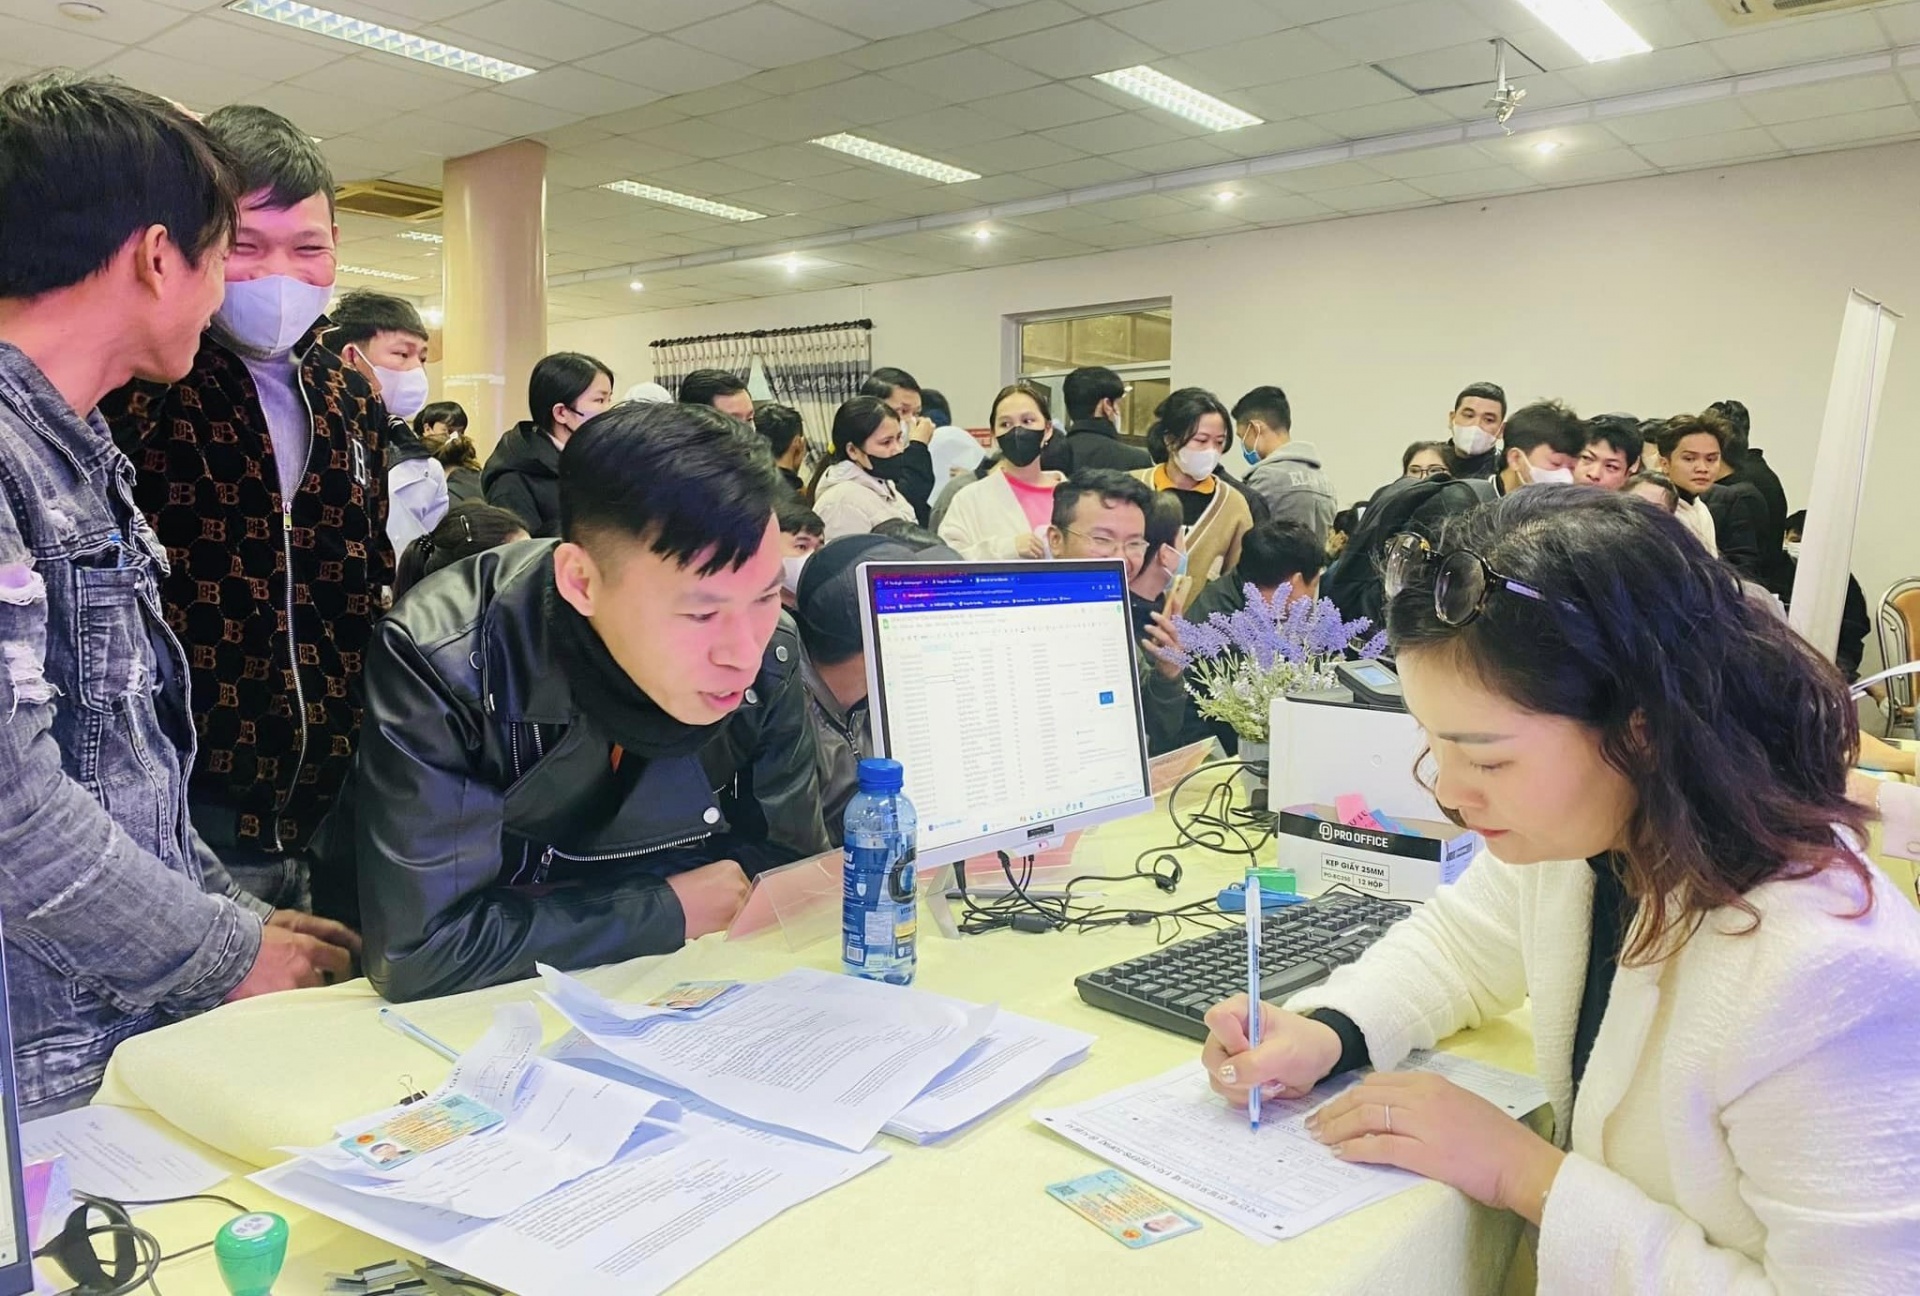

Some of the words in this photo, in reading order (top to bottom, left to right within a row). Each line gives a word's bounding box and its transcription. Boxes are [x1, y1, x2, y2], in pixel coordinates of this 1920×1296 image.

[1333, 828, 1353, 842] PRO
[1353, 832, 1389, 848] OFFICE
[1361, 866, 1385, 876] 25MM
[1358, 878, 1367, 886] 12
